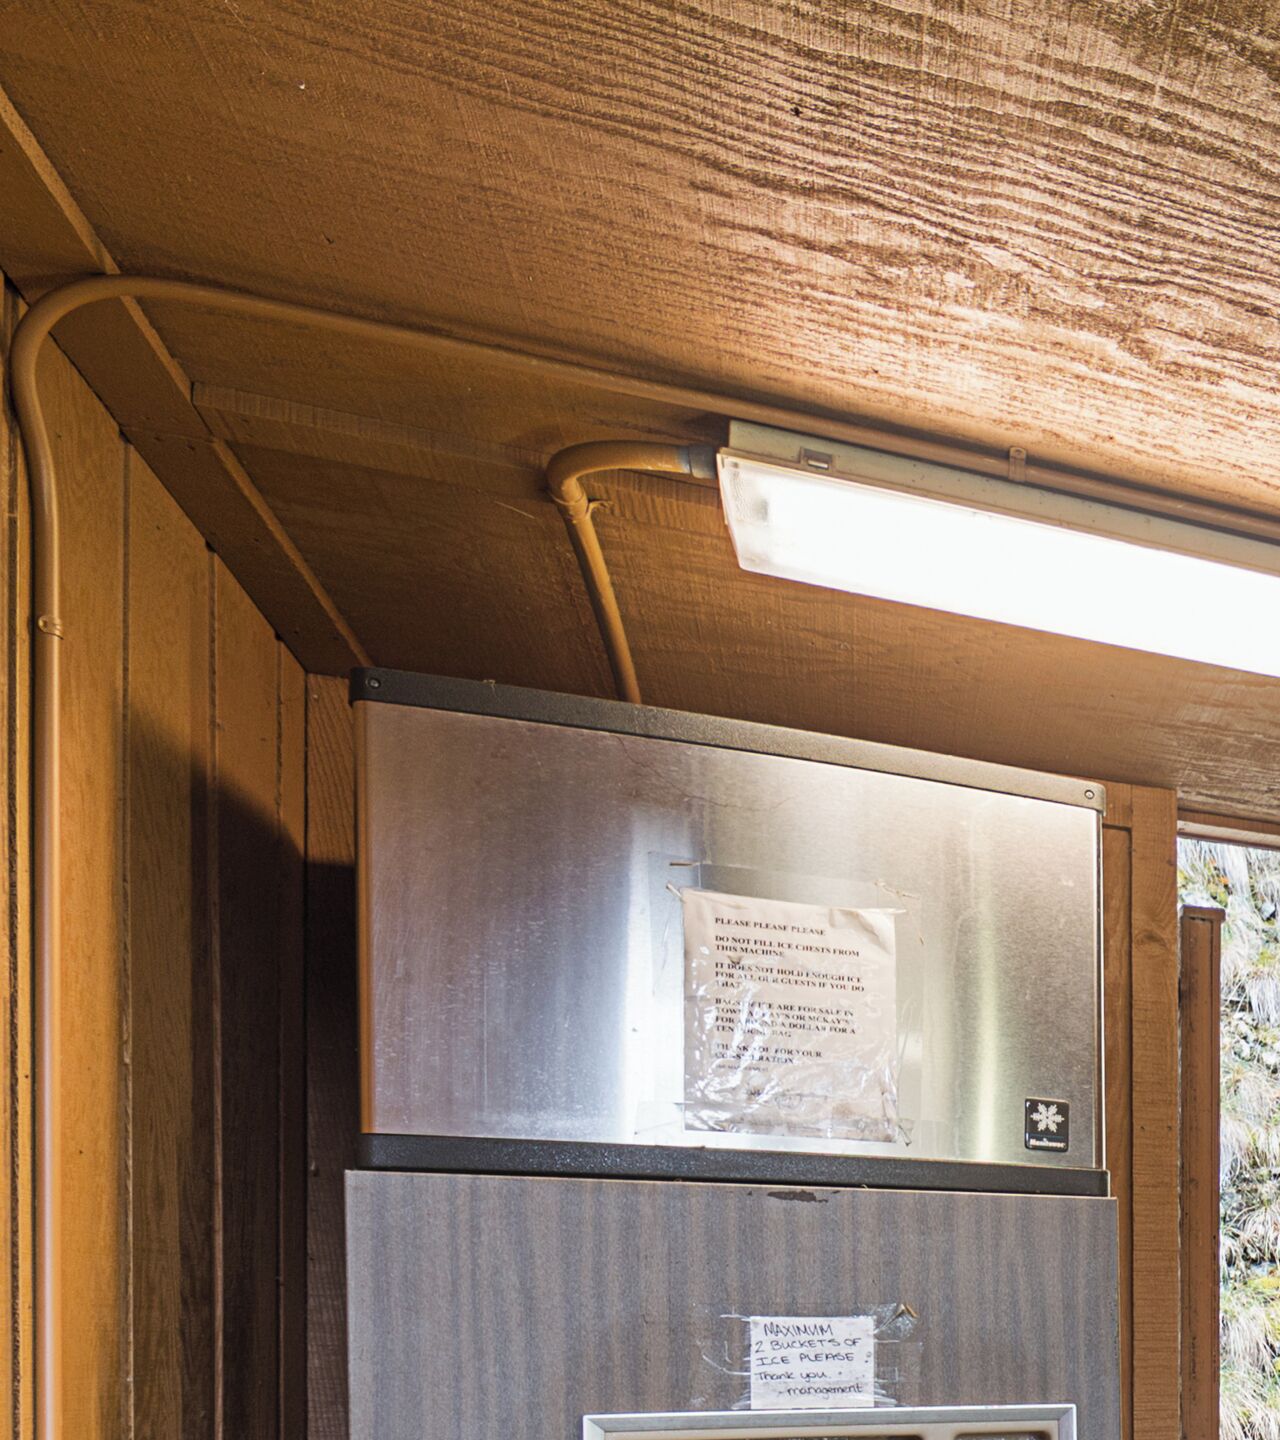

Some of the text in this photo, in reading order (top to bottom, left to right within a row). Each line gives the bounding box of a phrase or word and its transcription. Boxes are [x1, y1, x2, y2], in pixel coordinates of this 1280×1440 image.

[715, 917, 826, 936] PLEASE PLEASE PLEASE
[715, 936, 860, 957] DO NOT FILL ICE CHESTS FROM
[716, 944, 785, 957] THIS MACHINE
[727, 963, 752, 972] DOES
[756, 965, 774, 974] NOT
[776, 968, 804, 978] HOLD
[806, 971, 846, 981] ENOUGH
[847, 975, 862, 983] ICE
[715, 971, 735, 979] FOR
[780, 978, 816, 988] GUESTS
[830, 983, 850, 991] YOU
[851, 984, 865, 992] DO
[776, 1002, 795, 1011] ARE
[844, 1009, 854, 1017] IN
[715, 1016, 735, 1024] FOR
[830, 1026, 848, 1034] FOR
[763, 1322, 834, 1338] MAXIMUM
[754, 1338, 862, 1354] 2 BUCKETS OF
[756, 1353, 855, 1367] ICE PLEASE
[754, 1370, 796, 1382] Thank
